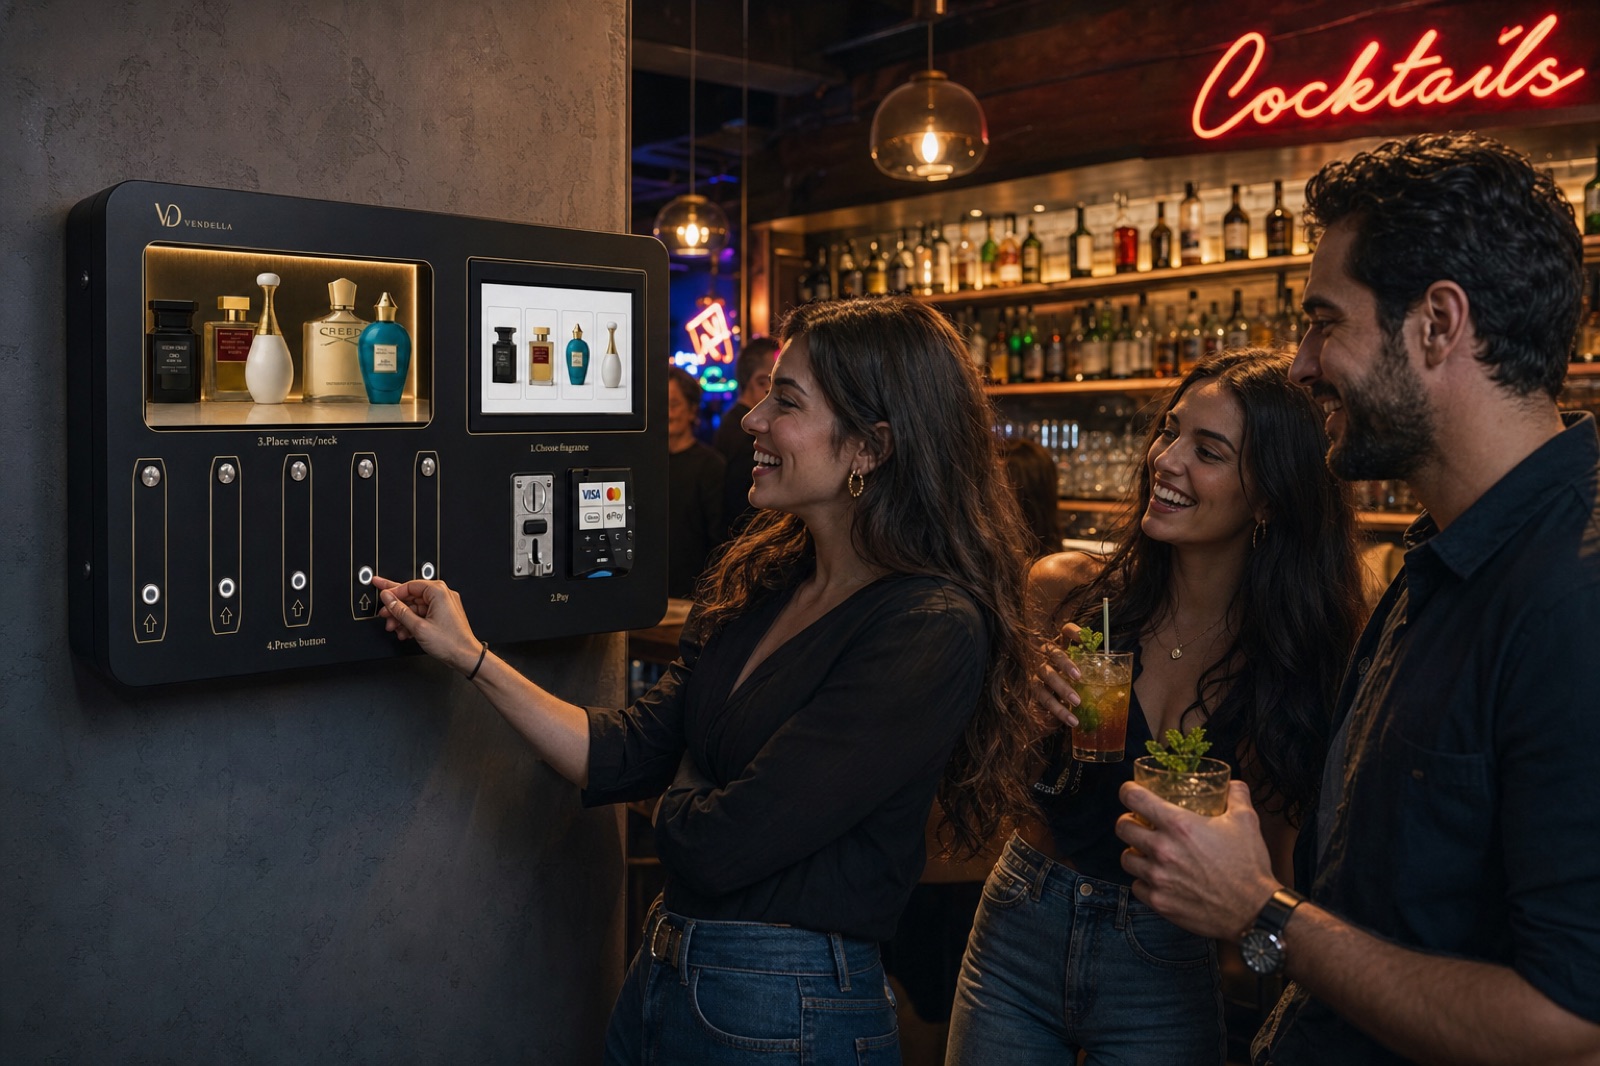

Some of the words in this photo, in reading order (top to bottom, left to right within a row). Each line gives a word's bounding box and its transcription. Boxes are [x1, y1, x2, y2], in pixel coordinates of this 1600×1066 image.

[1192, 14, 1585, 138] Cocktails
[155, 203, 182, 227] VD
[184, 219, 232, 230] VENDELLA
[257, 436, 289, 447] 3.Place
[291, 435, 338, 447] wrist/neck
[582, 489, 601, 500] VISA
[550, 593, 569, 603] 2.Pay
[267, 640, 297, 650] 4.Press
[298, 637, 326, 647] button
